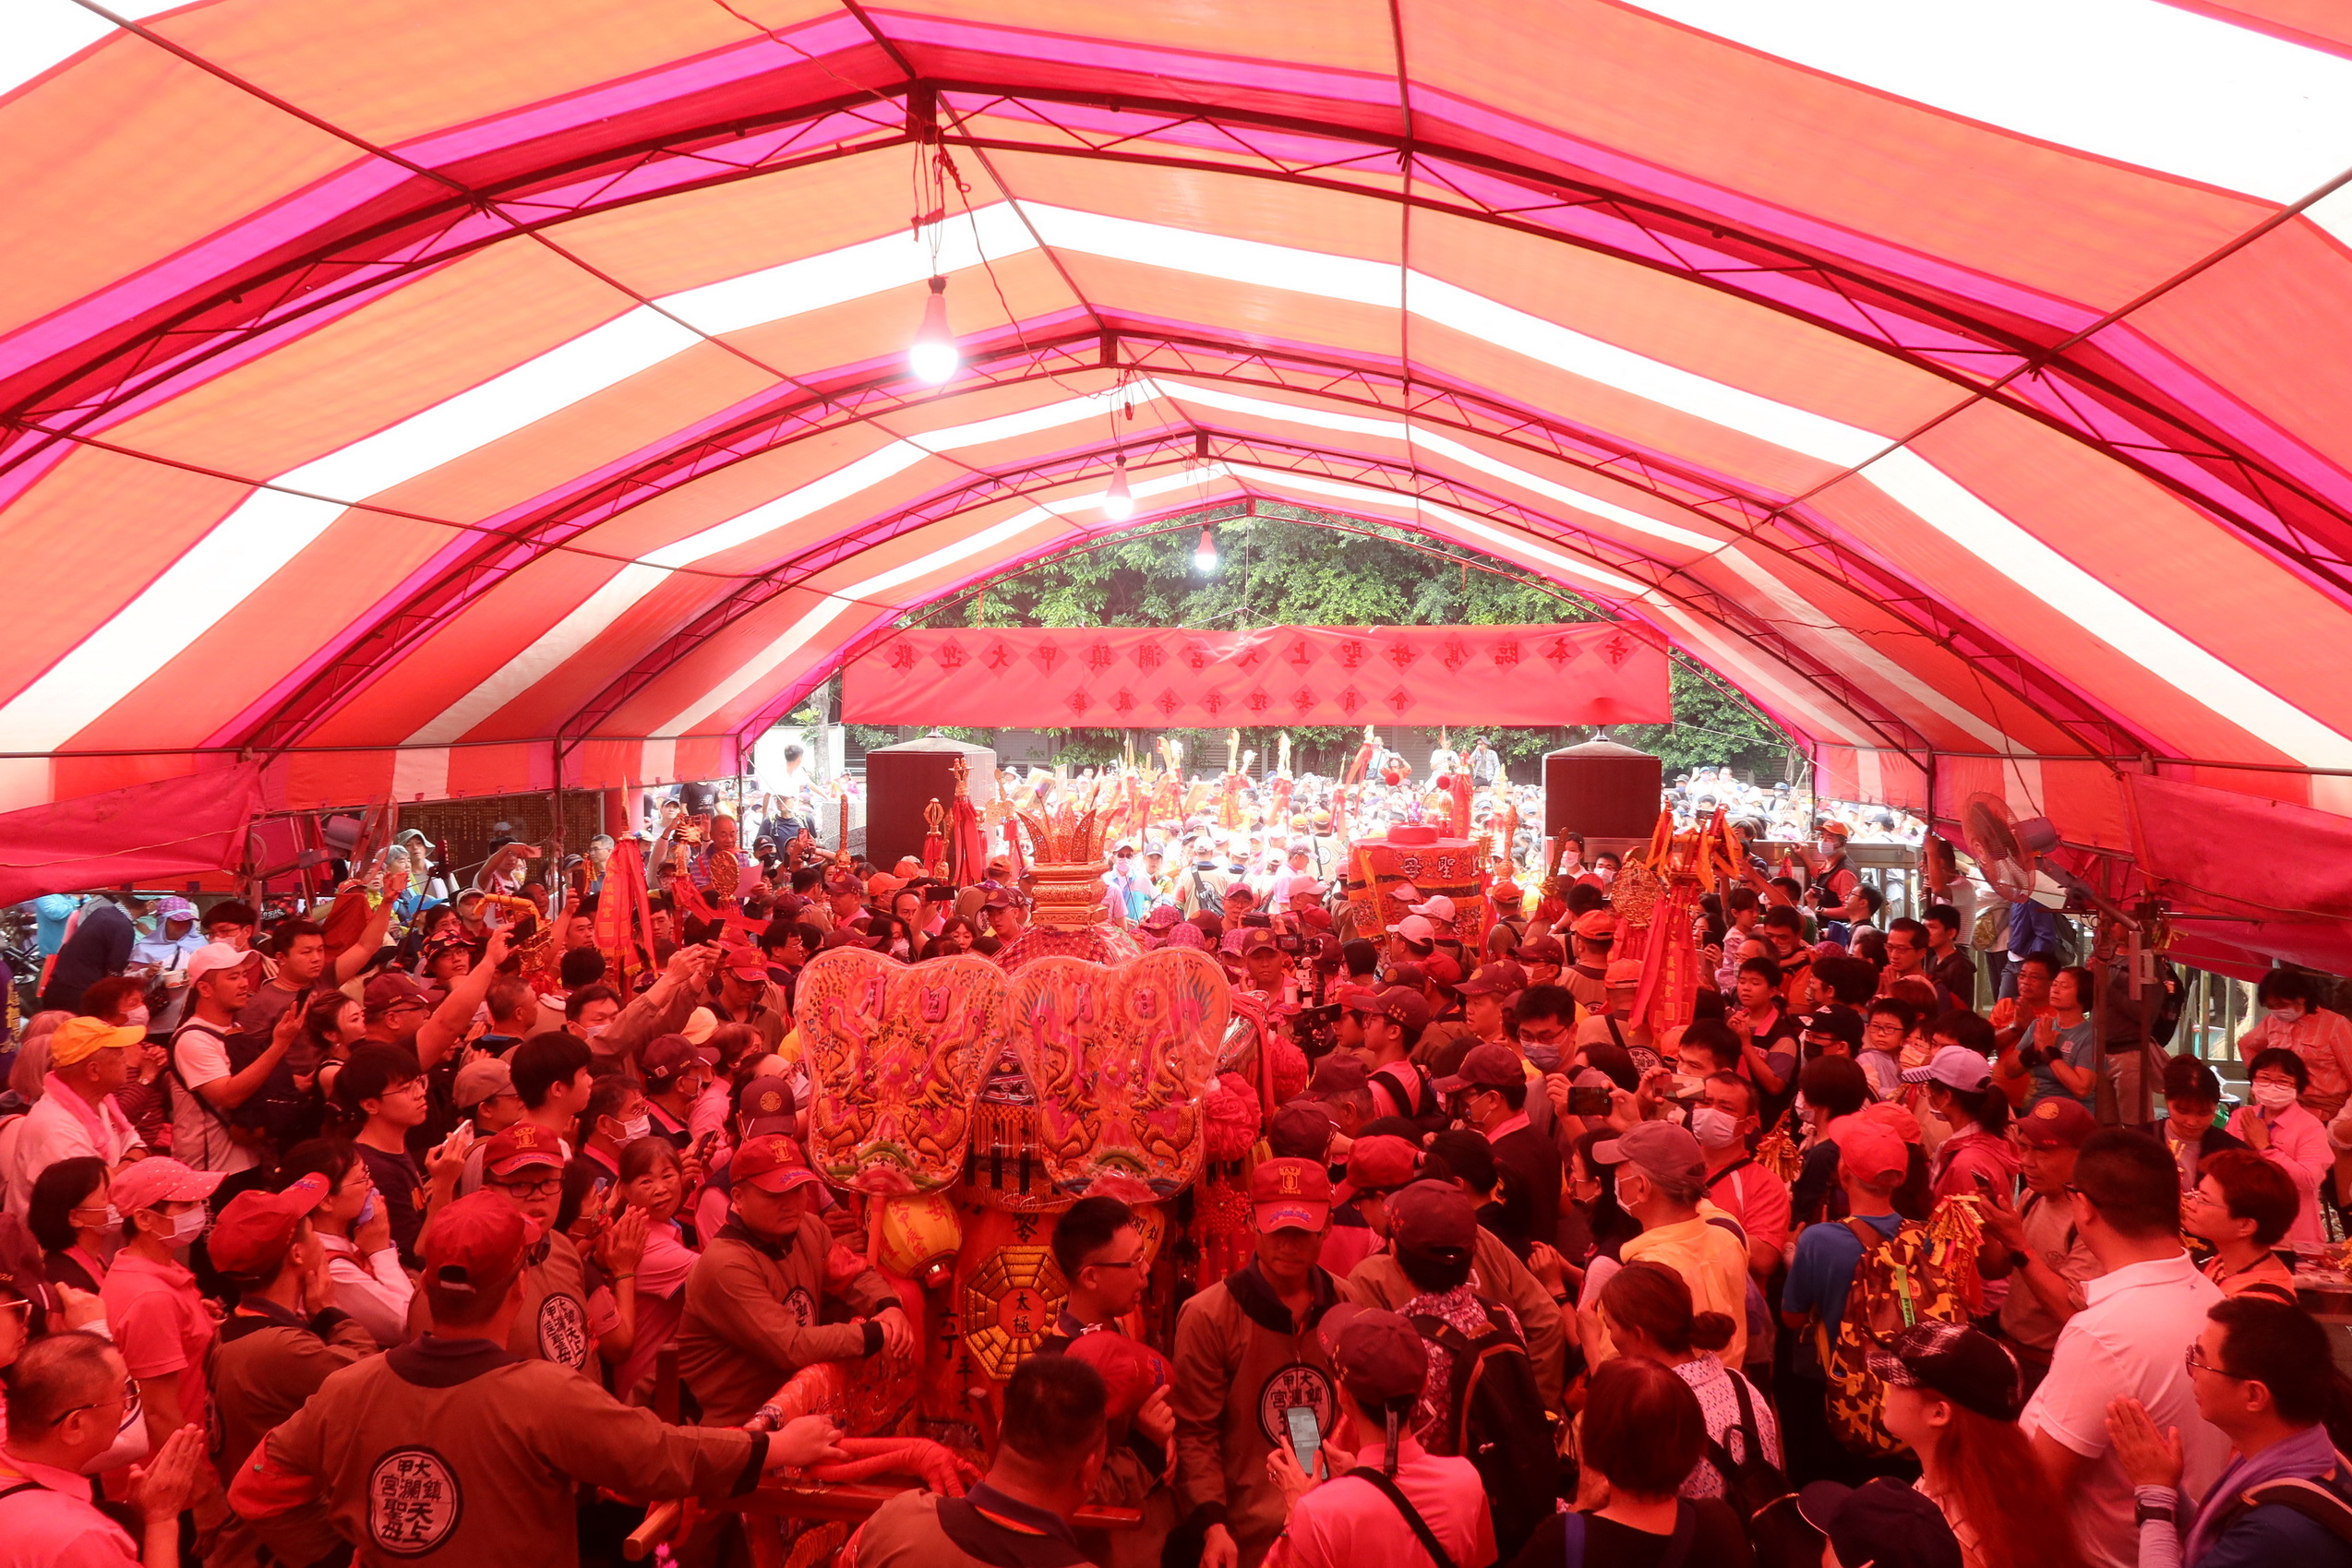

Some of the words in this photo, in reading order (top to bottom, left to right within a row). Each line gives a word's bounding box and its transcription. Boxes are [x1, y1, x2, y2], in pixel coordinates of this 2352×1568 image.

[1012, 1290, 1033, 1335] 太極
[397, 1458, 433, 1478] 大甲
[380, 1474, 443, 1502] 鎮瀾宮
